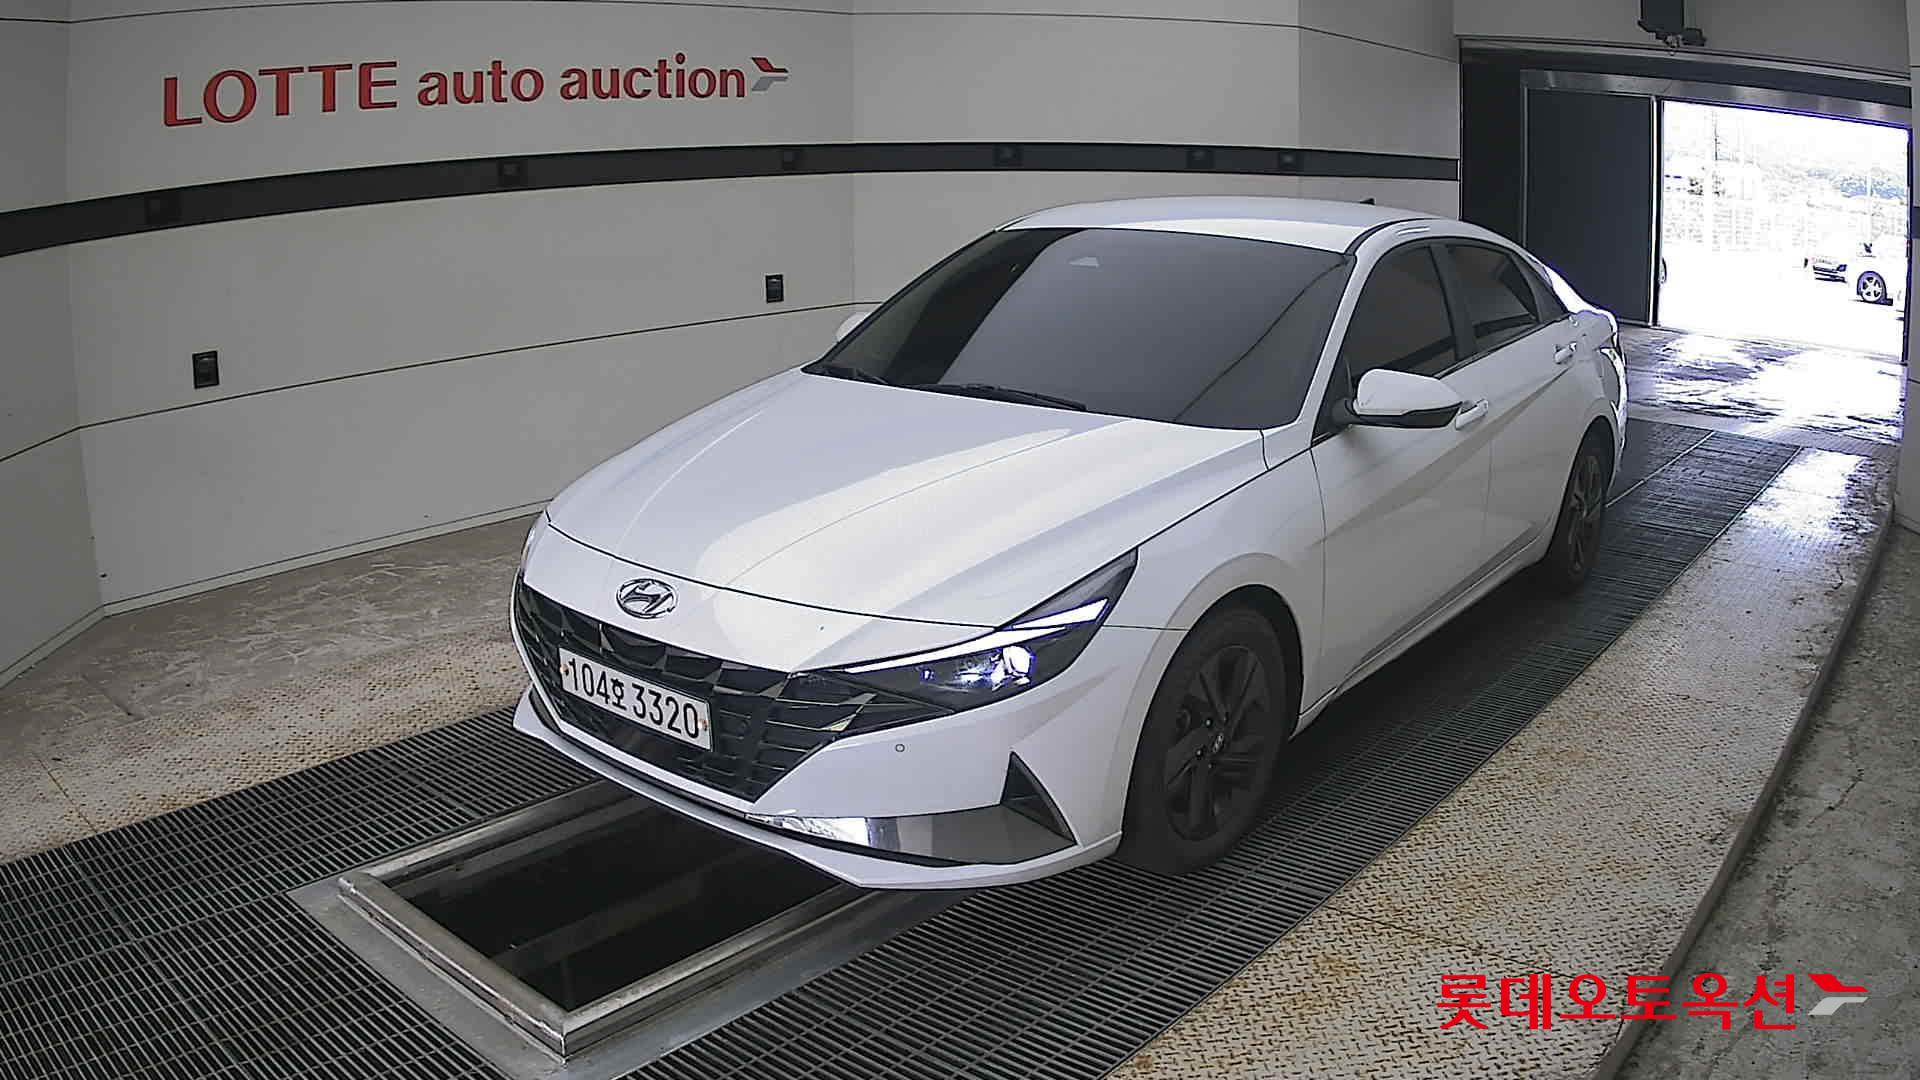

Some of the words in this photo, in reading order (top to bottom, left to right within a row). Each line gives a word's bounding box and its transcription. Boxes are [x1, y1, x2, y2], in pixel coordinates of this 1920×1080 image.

[163, 60, 398, 127] LOTTE
[416, 60, 545, 107] auto
[559, 52, 746, 100] auction
[569, 658, 627, 711] 104호
[631, 682, 699, 739] 3320
